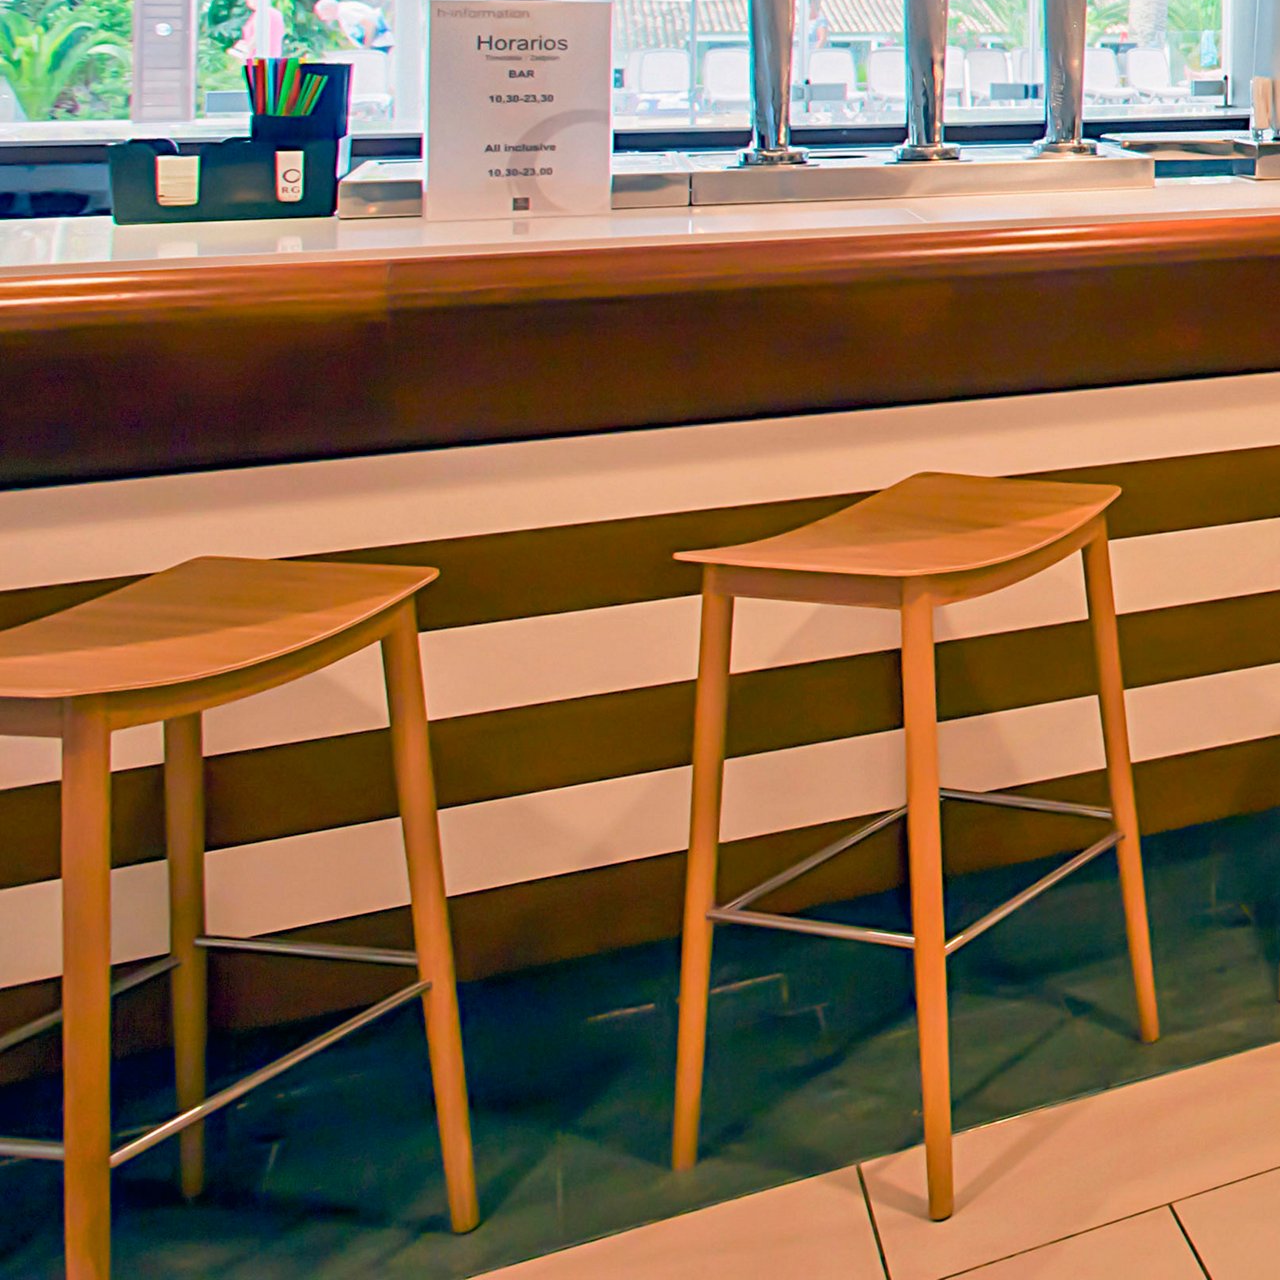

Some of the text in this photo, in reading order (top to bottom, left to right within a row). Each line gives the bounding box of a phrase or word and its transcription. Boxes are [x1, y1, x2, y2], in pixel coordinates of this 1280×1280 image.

[436, 7, 530, 19] h-information
[476, 34, 569, 52] Horarios
[508, 69, 535, 79] BAR
[484, 143, 557, 153] All inclusive
